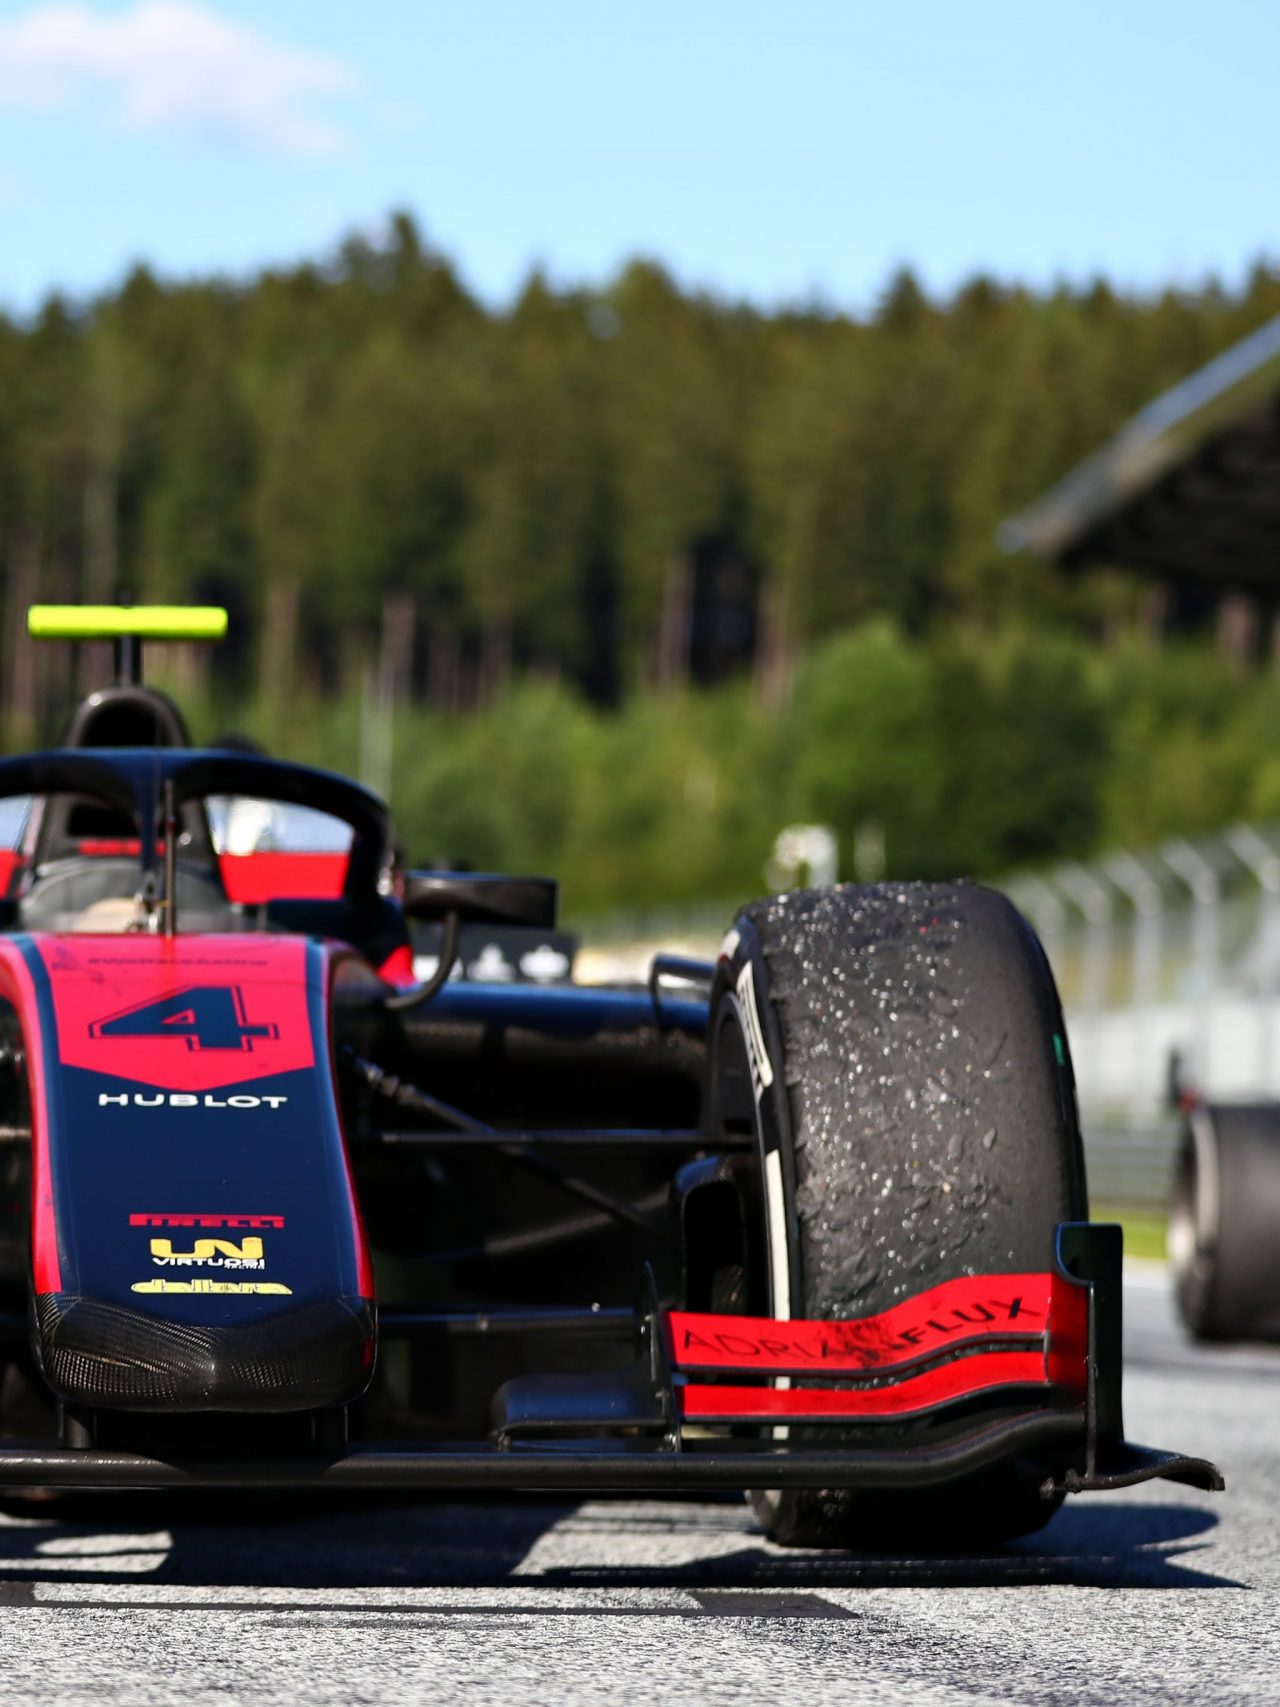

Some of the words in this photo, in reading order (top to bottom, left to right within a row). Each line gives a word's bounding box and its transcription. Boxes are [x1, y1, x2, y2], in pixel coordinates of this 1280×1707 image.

[88, 985, 280, 1052] 4
[98, 1093, 288, 1109] HUBLOT
[129, 1213, 285, 1229] PIRELLI
